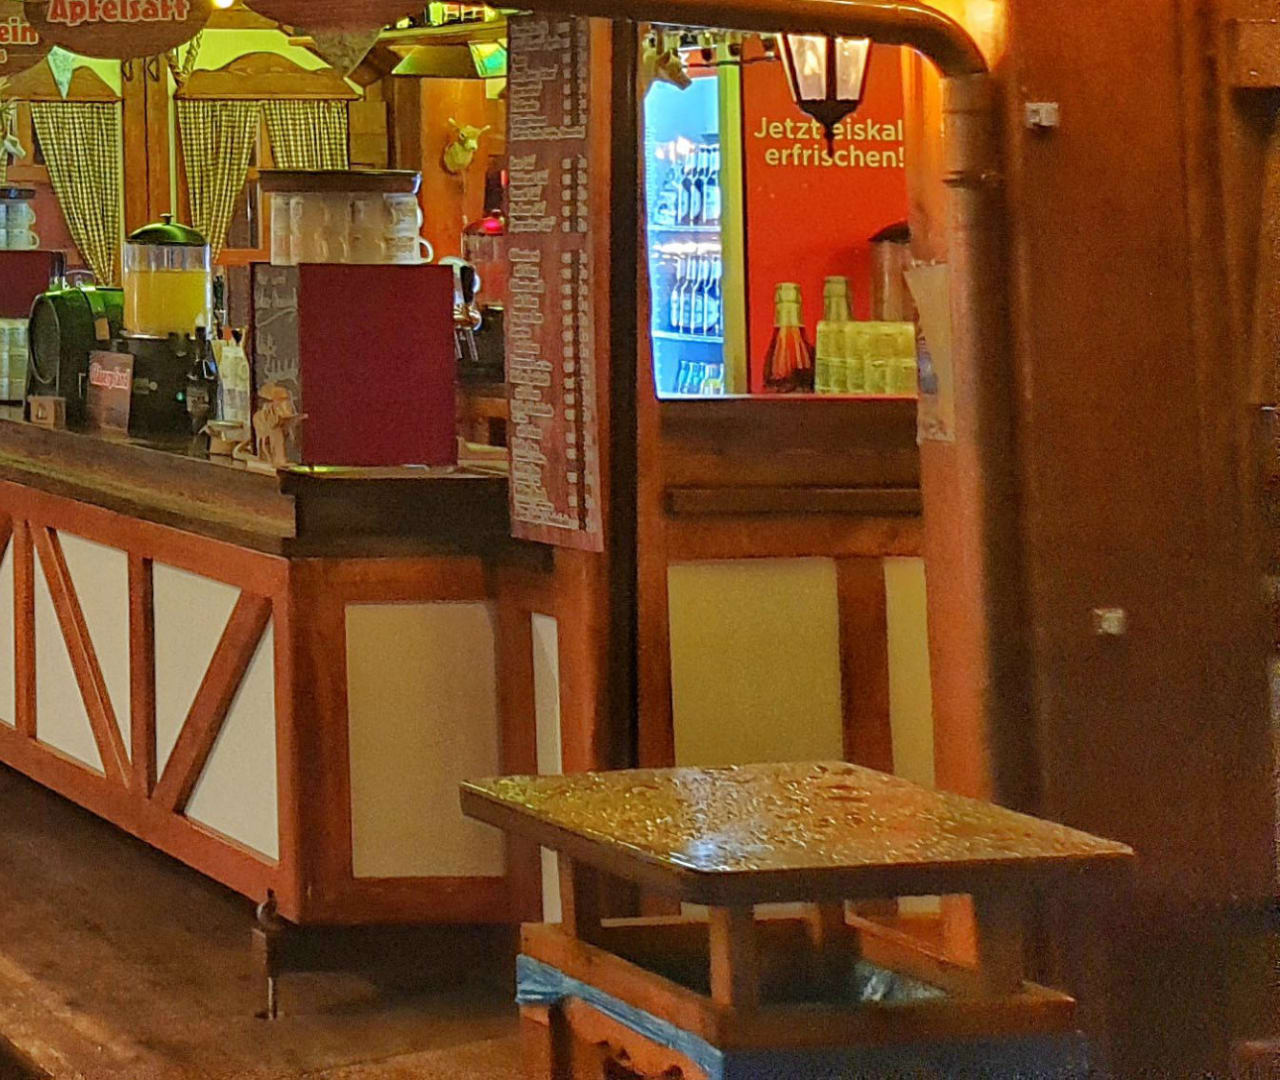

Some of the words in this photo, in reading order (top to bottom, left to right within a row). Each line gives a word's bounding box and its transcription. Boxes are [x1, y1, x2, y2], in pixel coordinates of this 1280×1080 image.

[754, 117, 821, 139] Jetzt
[833, 117, 904, 141] eiskal
[764, 144, 905, 168] erfrischen!
